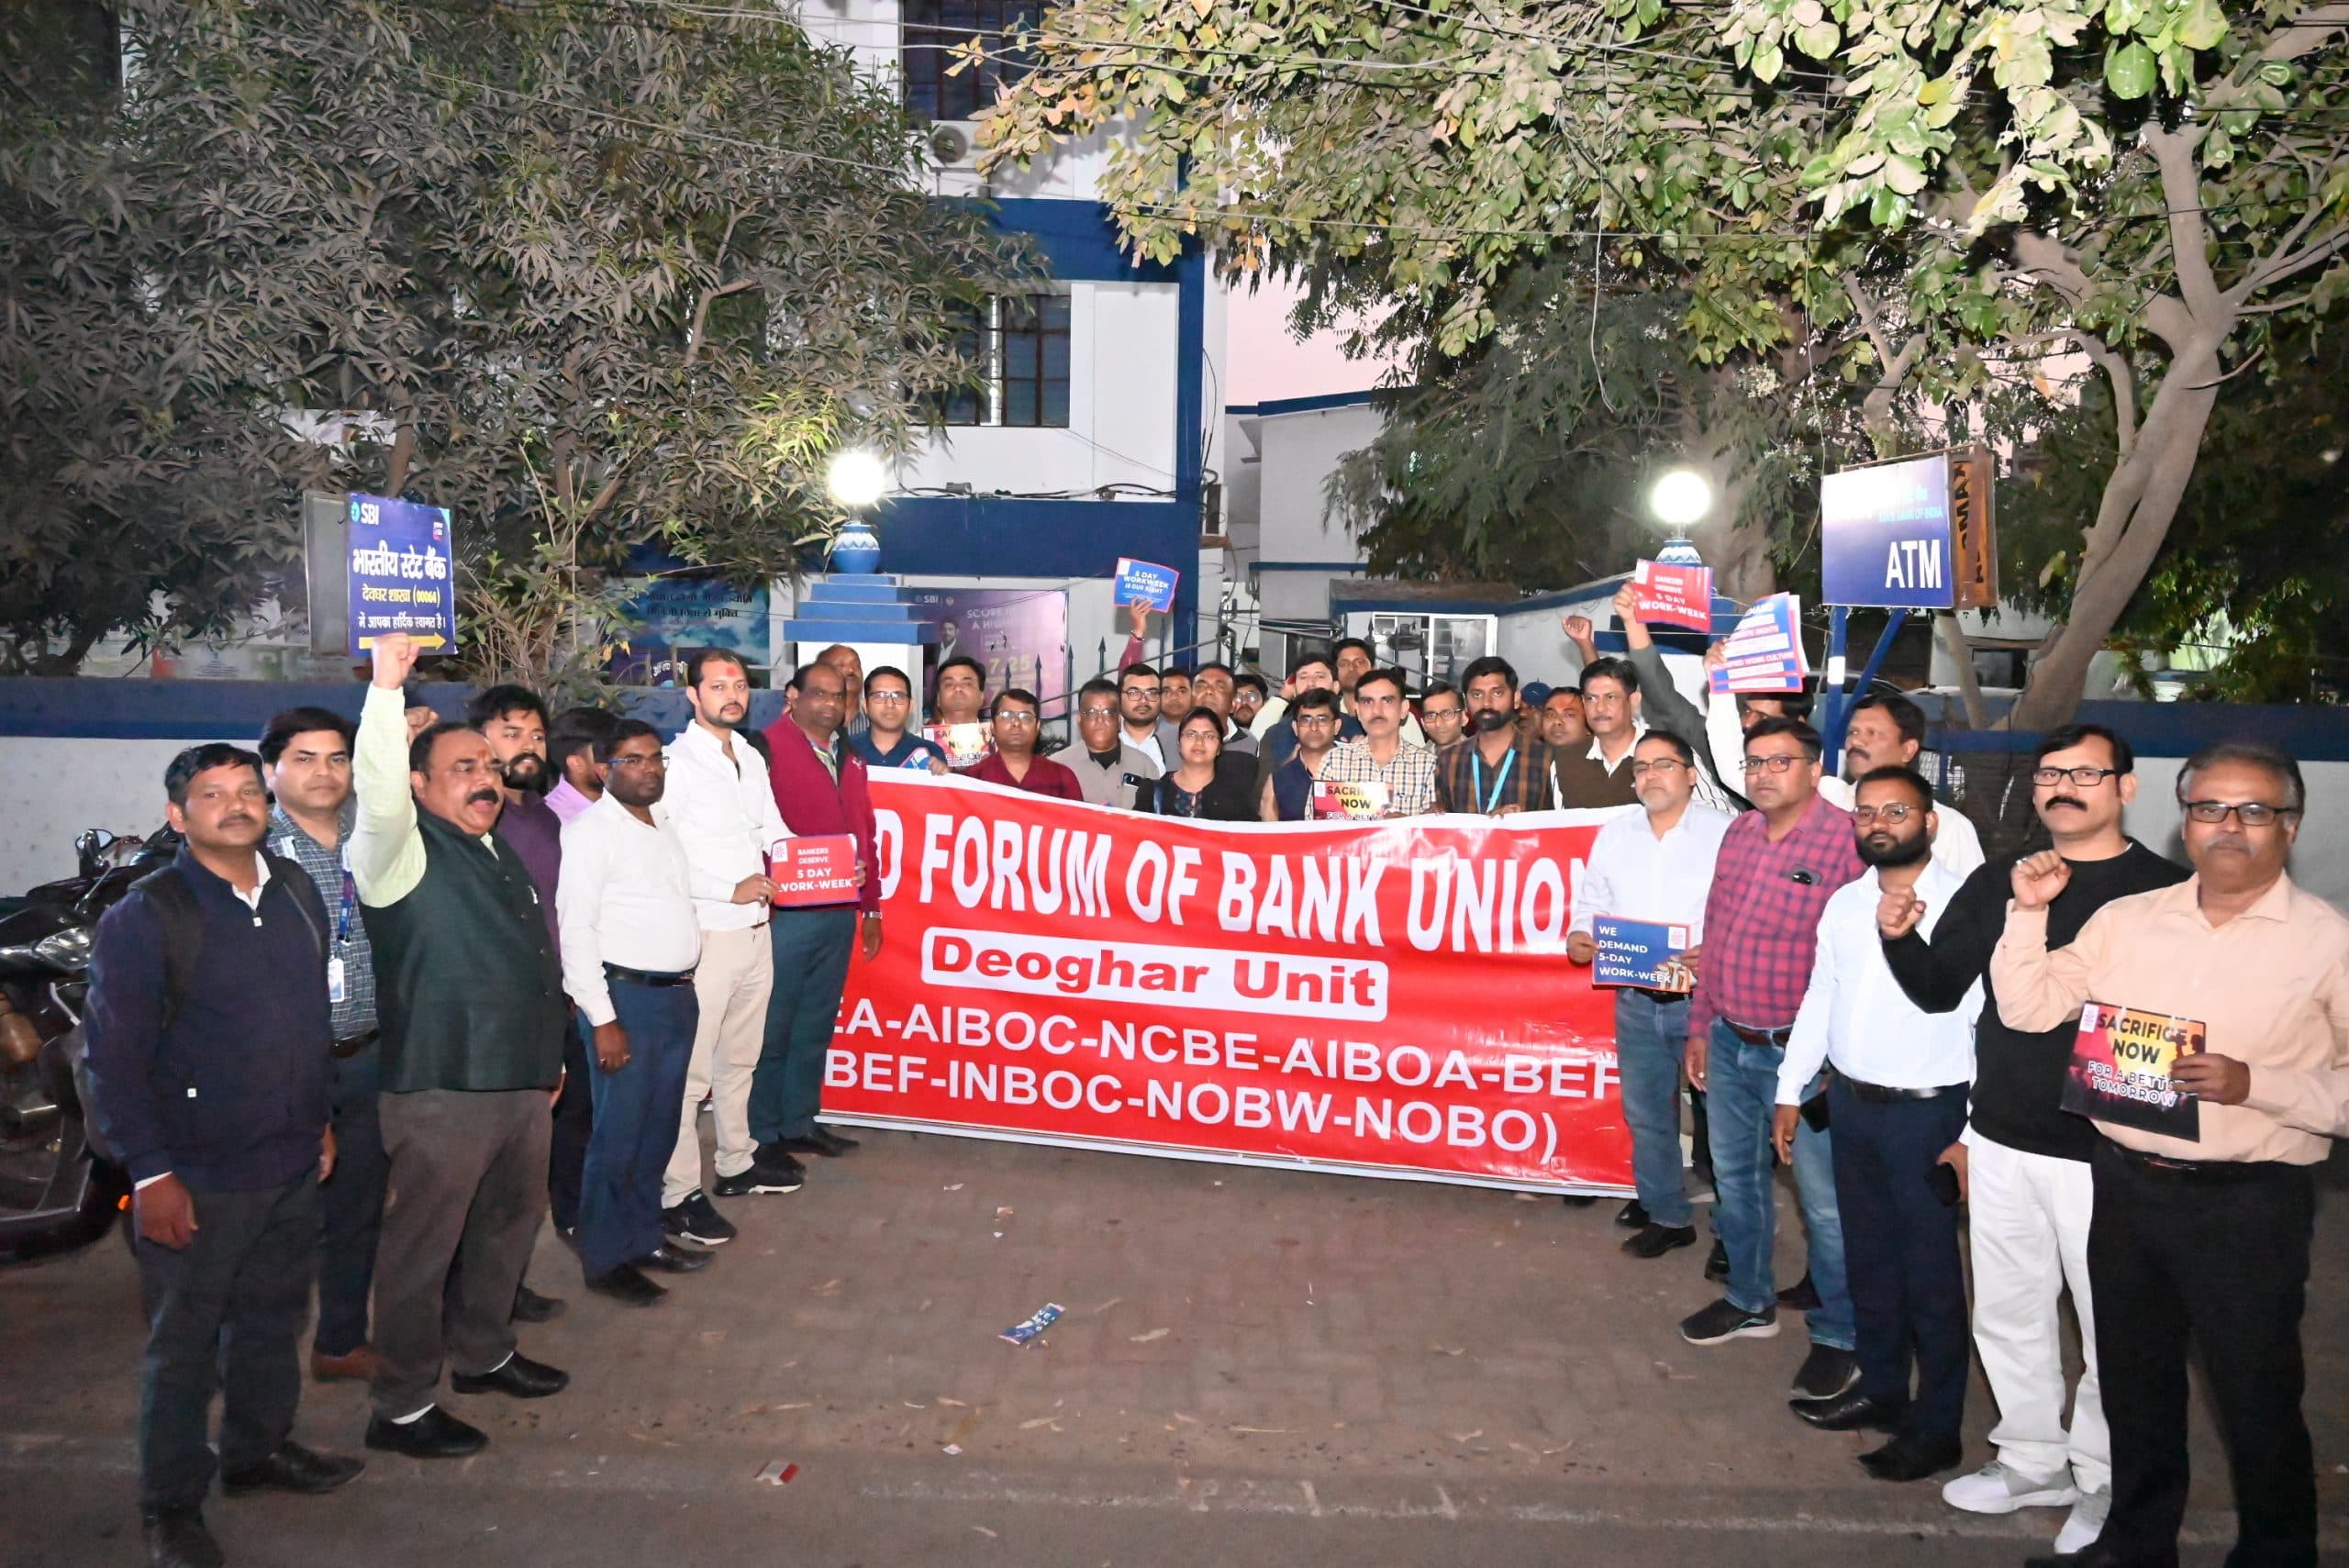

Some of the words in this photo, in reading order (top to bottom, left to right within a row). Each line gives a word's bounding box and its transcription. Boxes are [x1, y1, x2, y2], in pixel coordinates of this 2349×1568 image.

[361, 503, 380, 525] SBI
[352, 539, 399, 576] भारतीय
[400, 544, 423, 578] स्टेट
[424, 545, 446, 580] बैंक
[1885, 539, 1942, 588] ATM
[1123, 574, 1169, 589] WORKWEEK
[388, 587, 411, 603] शाखा
[413, 584, 440, 607] (00064)
[924, 595, 939, 604] SBI
[1664, 595, 1686, 605] DAY
[1639, 601, 1707, 620] WORK-WEEK
[367, 616, 391, 628] आपका
[392, 611, 414, 628] हार्दिक
[415, 616, 435, 629] स्वागत
[1327, 785, 1364, 796] SACRI
[1341, 798, 1372, 809] NOW
[797, 847, 829, 855] BANKERS
[798, 856, 829, 864] DESERVE
[797, 870, 805, 879] 5
[807, 867, 832, 878] DAY
[874, 808, 904, 900] D
[918, 813, 1112, 918] FORUM
[1126, 840, 1202, 926] OF
[1218, 851, 1389, 948] BANK
[1598, 925, 1618, 937] WE
[1598, 940, 1649, 953] DEMAND
[1598, 952, 1632, 964] 5-DAY
[932, 935, 1210, 994] Deoghar
[1233, 959, 1376, 1007] Unit
[1599, 967, 1672, 984] WORK-WEEK
[2098, 1013, 2188, 1047] SACRIFICE
[2112, 1039, 2161, 1064] NOW
[2087, 1061, 2116, 1079] FOR
[2116, 1069, 2125, 1082] A
[2092, 1076, 2178, 1107] TOMORROW
